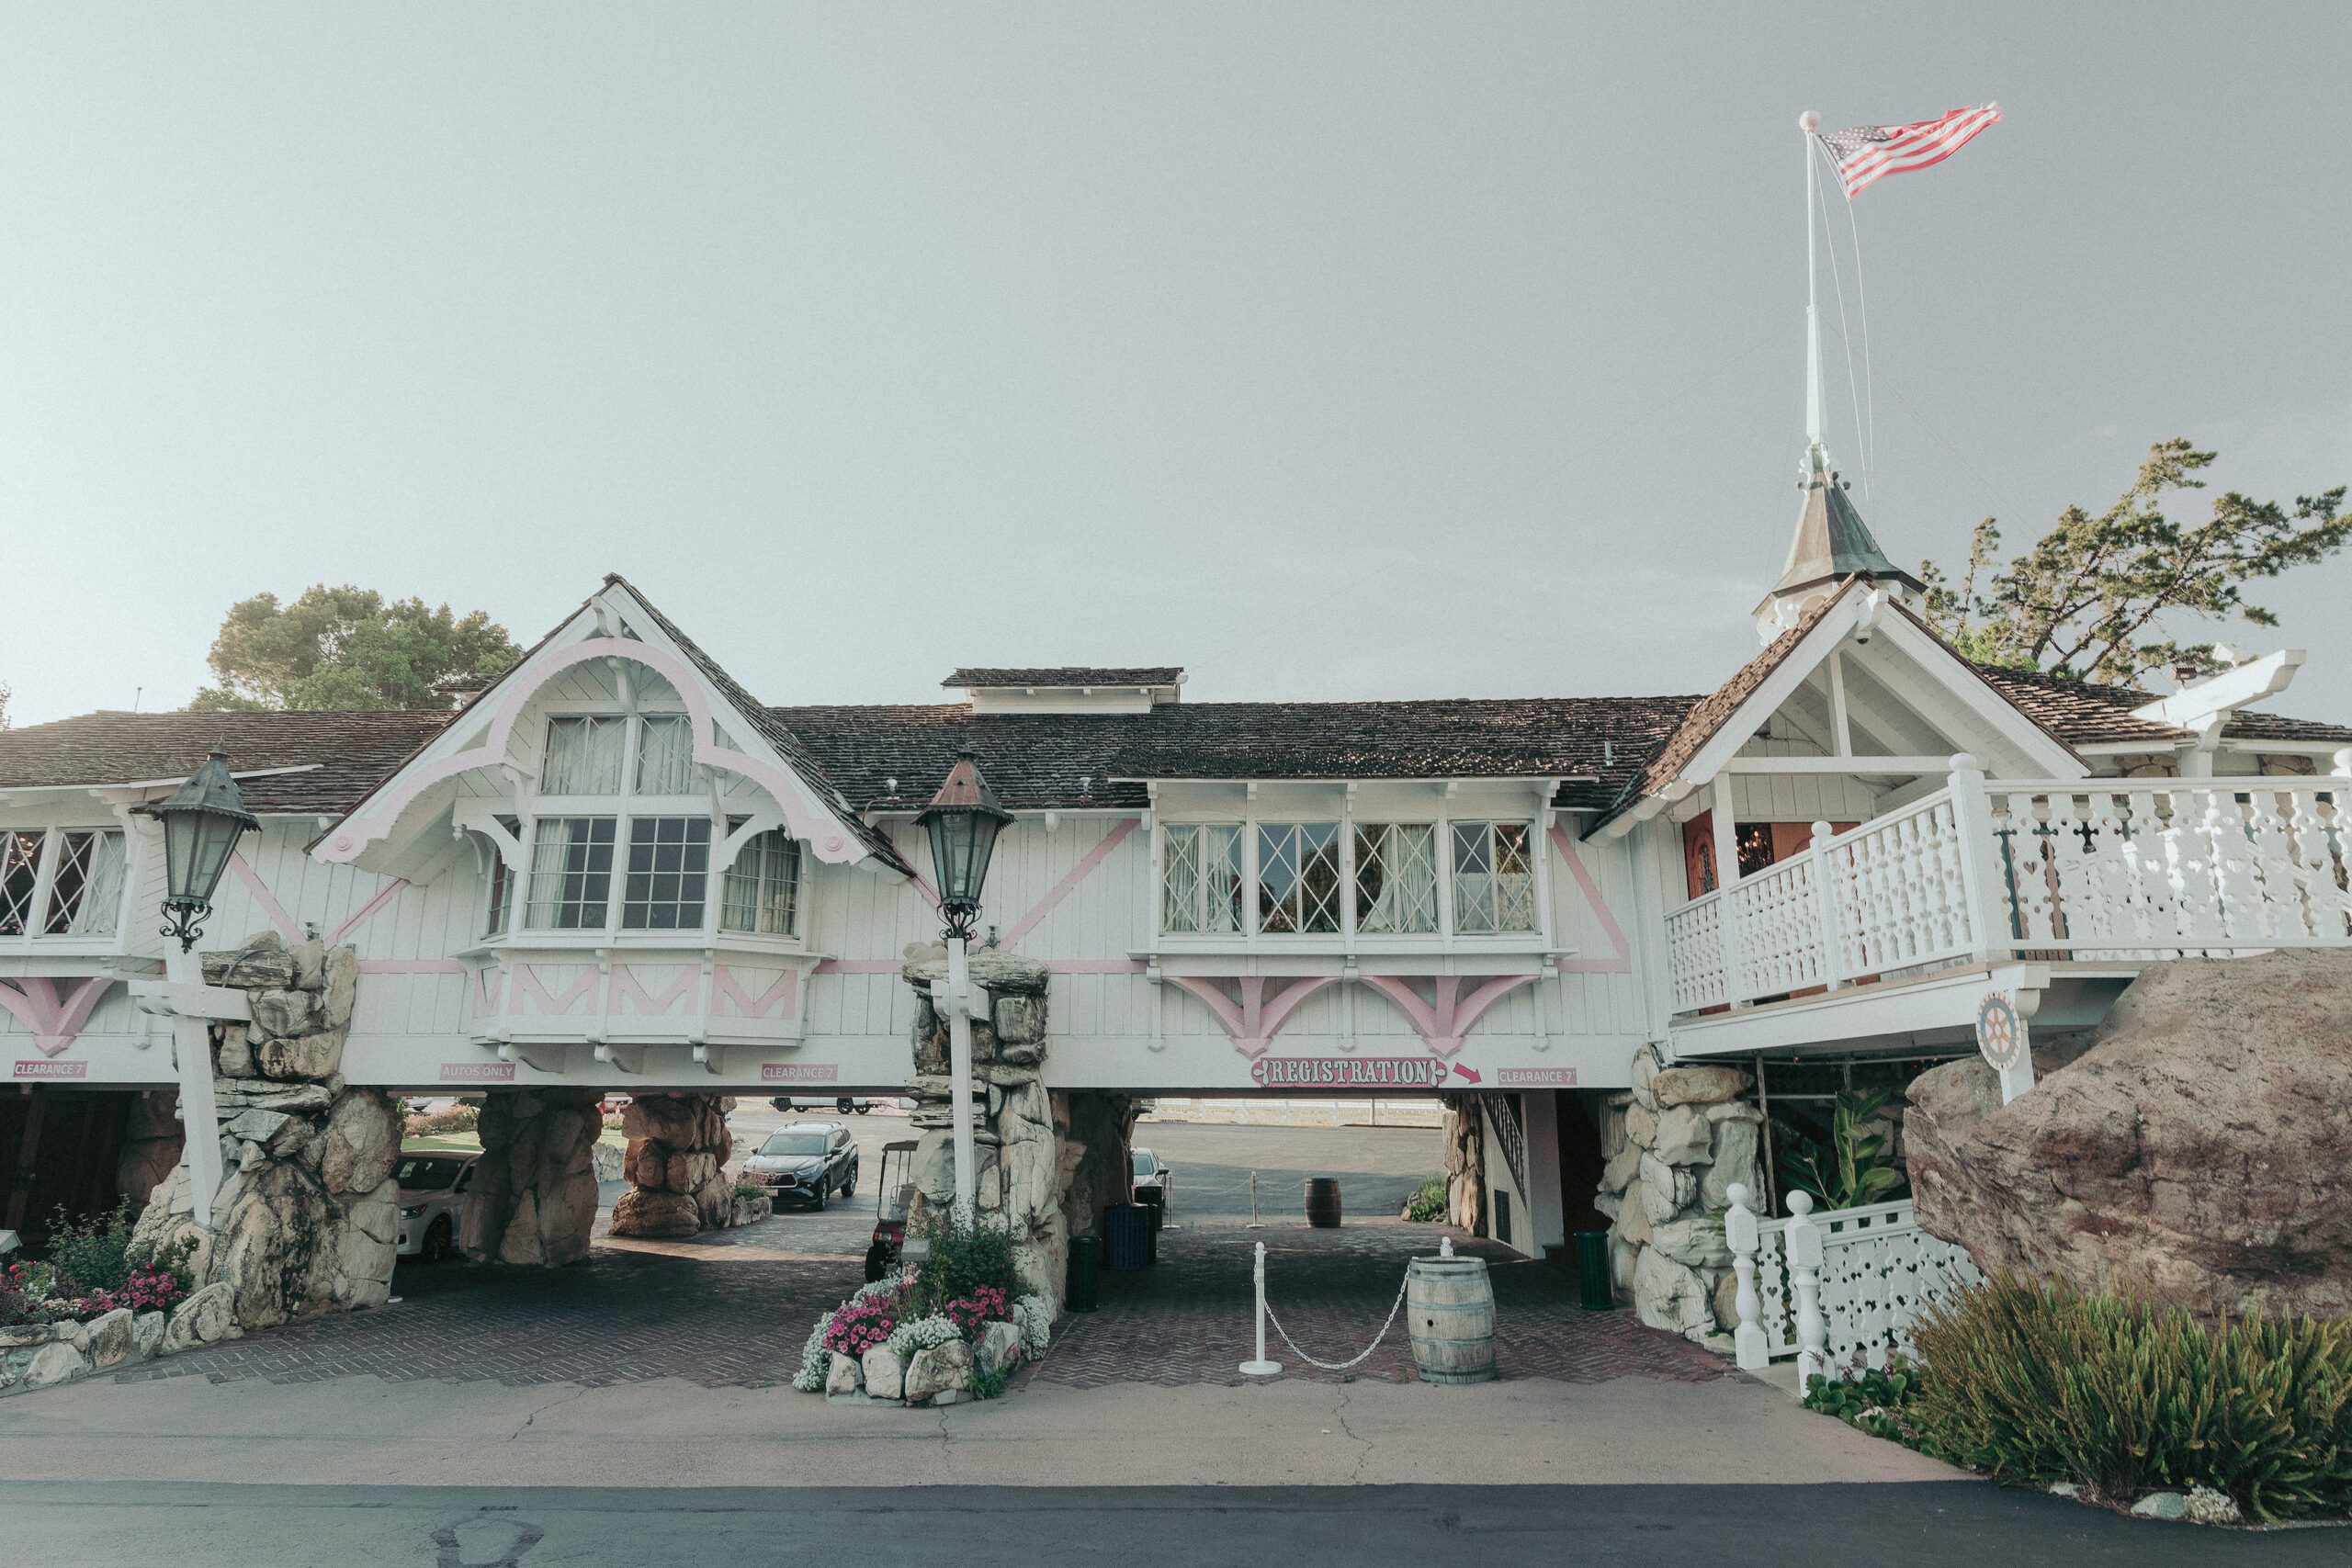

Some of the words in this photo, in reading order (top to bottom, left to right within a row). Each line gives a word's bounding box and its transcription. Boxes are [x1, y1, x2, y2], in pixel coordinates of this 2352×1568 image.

[15, 1064, 74, 1075] CLEARANCE
[443, 1066, 480, 1076] AUTOS
[482, 1066, 513, 1077] ONLY
[763, 1067, 823, 1078] CLEARANCE
[1270, 1059, 1430, 1084] REGISTRATION
[1499, 1071, 1563, 1082] CLEARANCE
